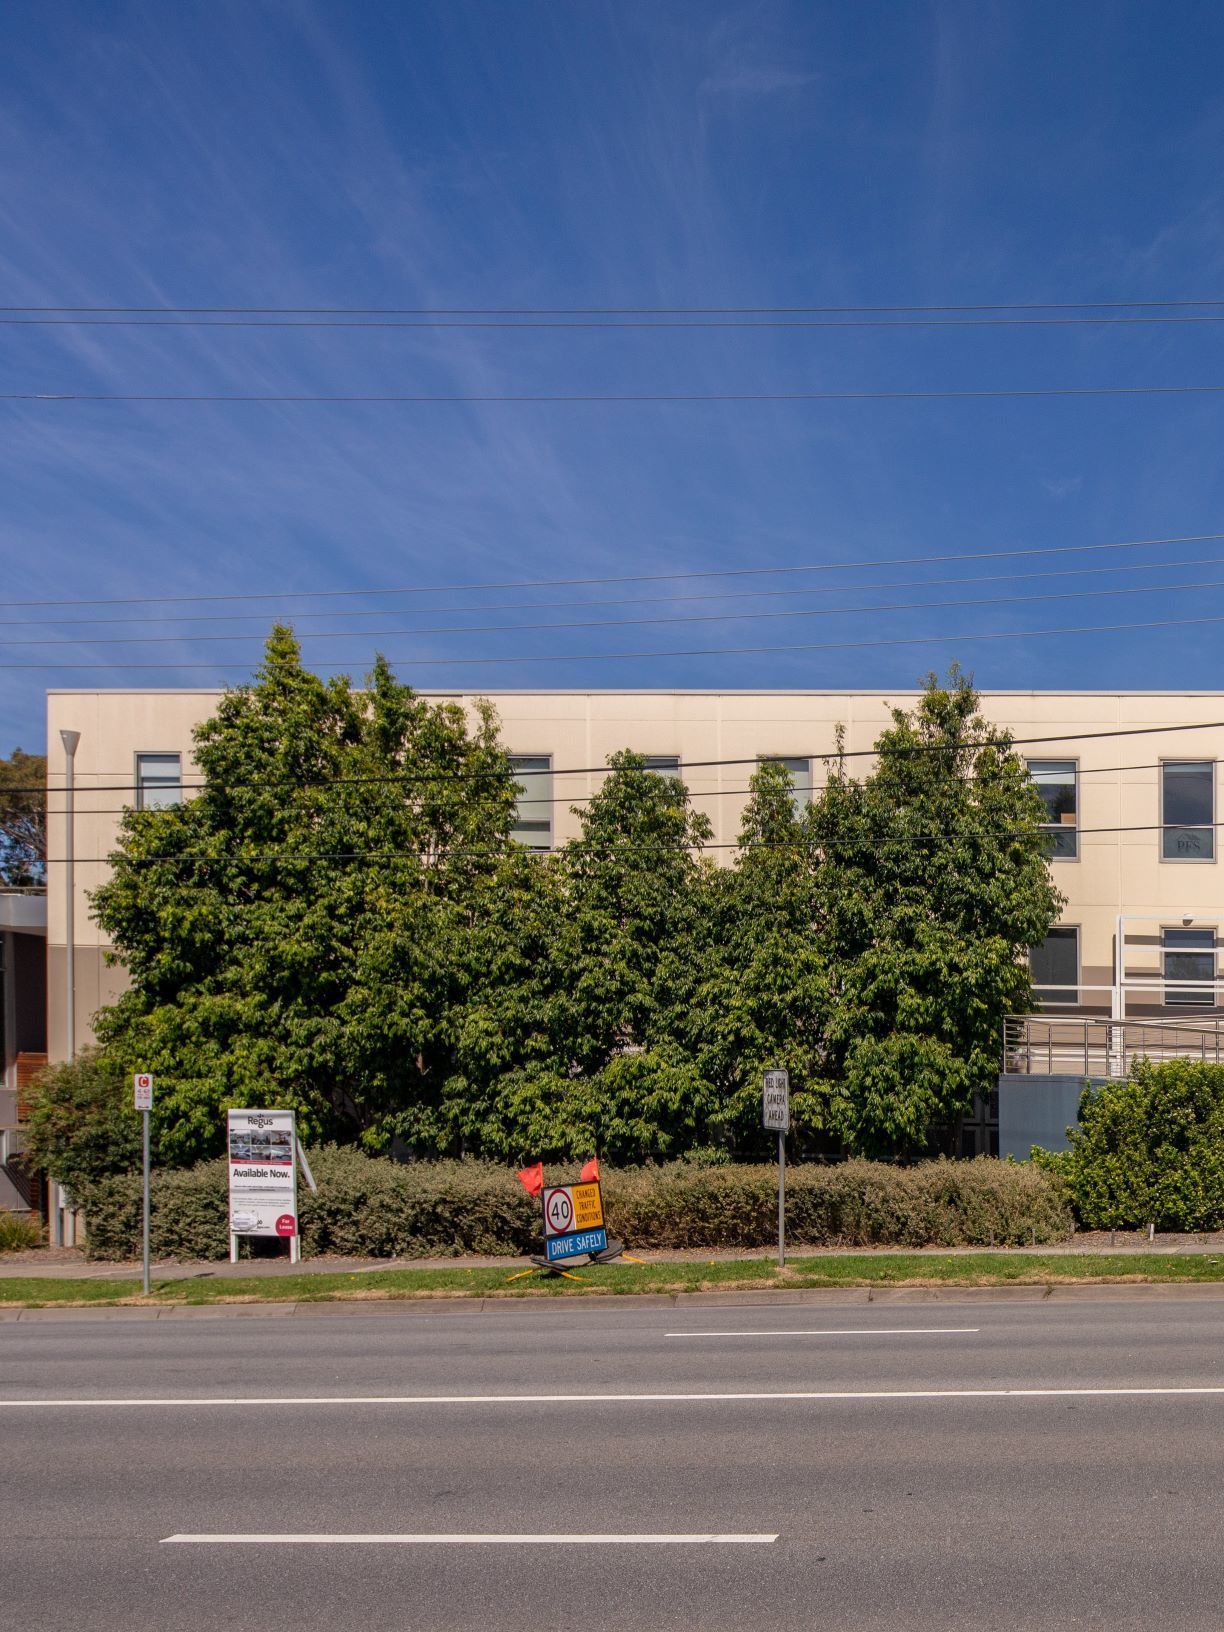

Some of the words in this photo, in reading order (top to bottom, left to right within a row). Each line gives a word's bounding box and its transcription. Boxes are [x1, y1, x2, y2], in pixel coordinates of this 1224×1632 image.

[140, 1077, 148, 1087] C
[765, 1077, 774, 1089] RED
[767, 1093, 785, 1105] CAMERA
[769, 1110, 784, 1121] AHEAD
[247, 1116, 273, 1128] Regus
[233, 1168, 268, 1178] Available
[269, 1169, 290, 1178] Now.
[576, 1188, 596, 1199] CHANGED
[552, 1200, 569, 1220] 40
[579, 1200, 596, 1210] TRAFFIC
[577, 1210, 601, 1223] CONDITIONS
[552, 1238, 574, 1255] DRIVE
[576, 1233, 602, 1250] SAFELY
